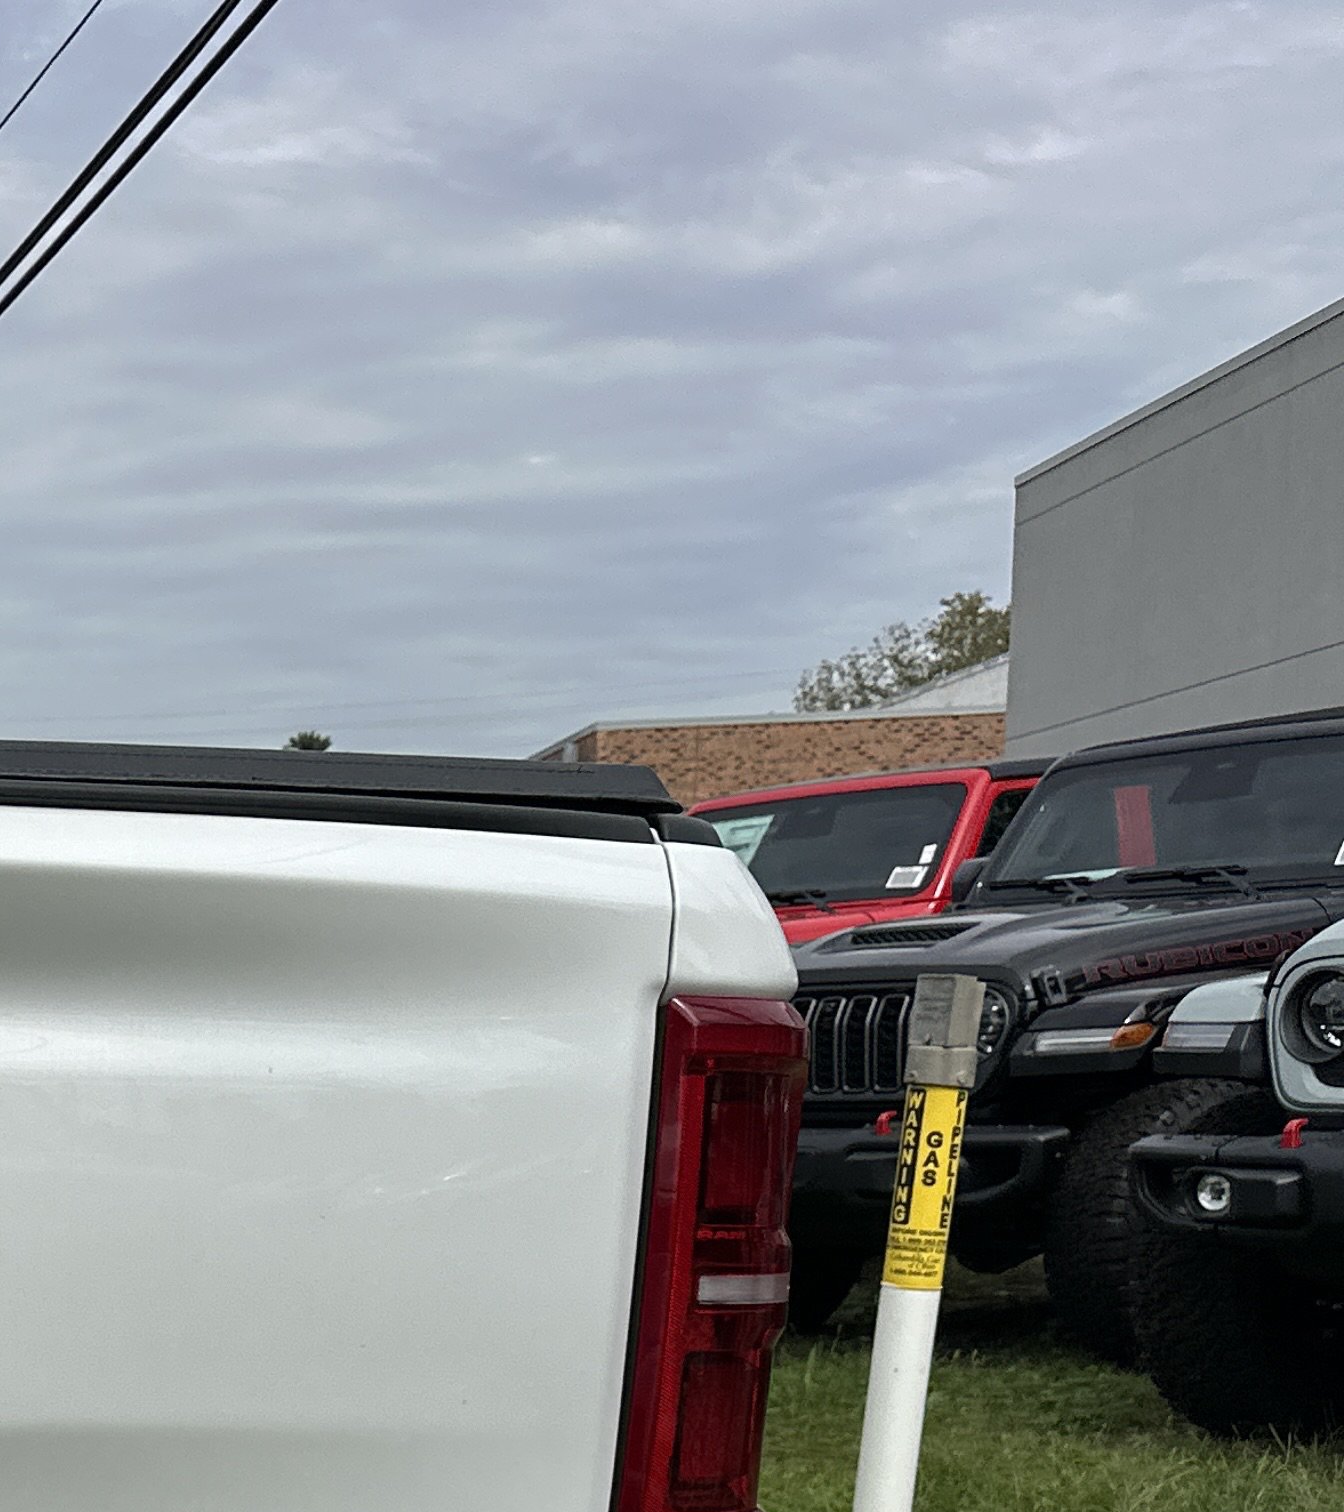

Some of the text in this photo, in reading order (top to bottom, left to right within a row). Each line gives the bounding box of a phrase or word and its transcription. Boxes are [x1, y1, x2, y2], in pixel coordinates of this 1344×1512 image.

[1081, 928, 1315, 983] RUBICON
[892, 1090, 924, 1223] WARNING
[921, 1131, 944, 1186] GAS
[939, 1090, 967, 1229] PIPELINE
